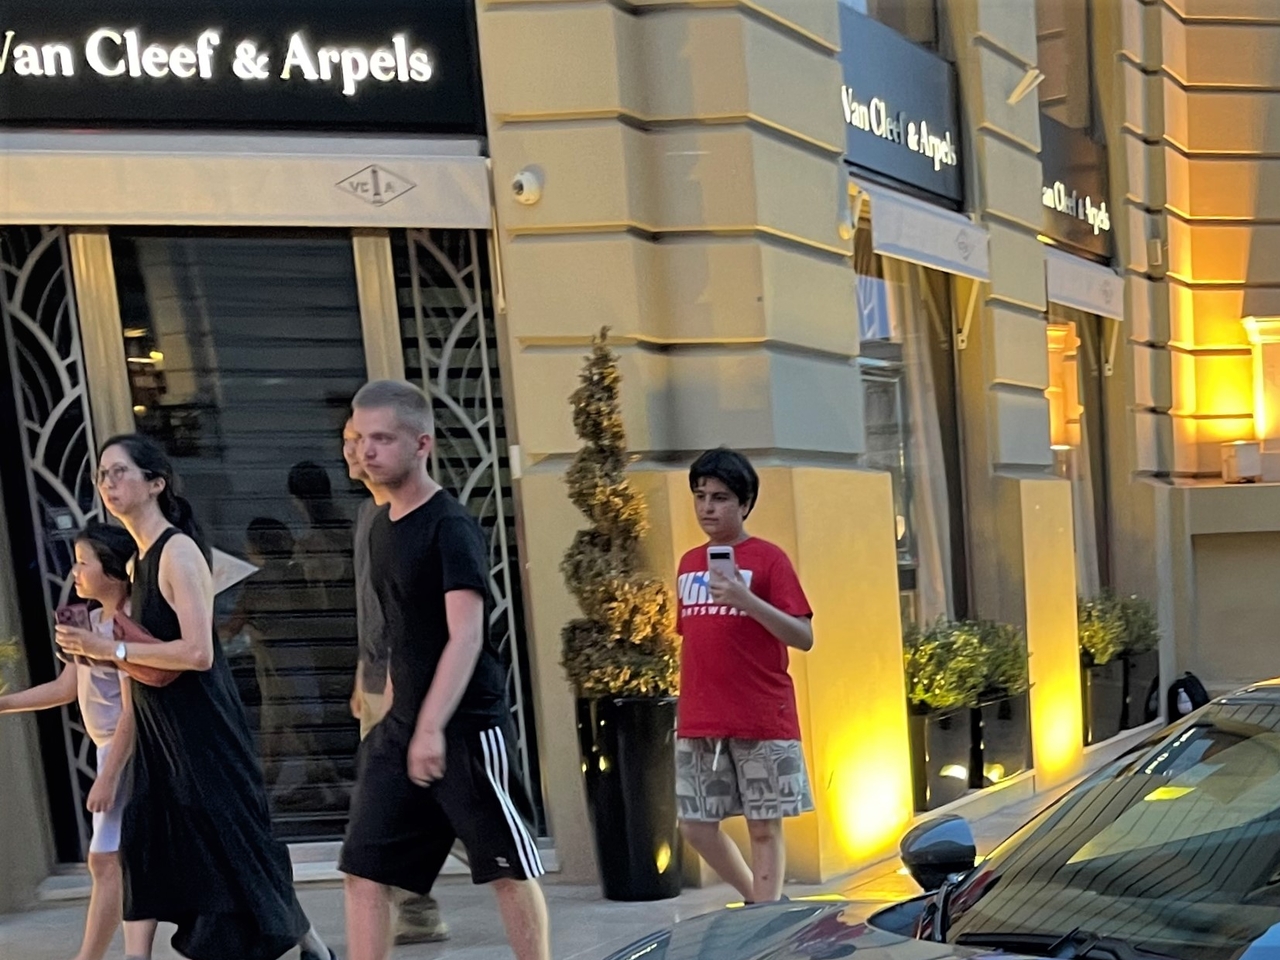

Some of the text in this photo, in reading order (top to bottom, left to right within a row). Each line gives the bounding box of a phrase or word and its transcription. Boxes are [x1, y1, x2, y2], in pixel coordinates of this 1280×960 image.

[85, 30, 220, 78] Cleef
[232, 41, 270, 80] &
[281, 32, 433, 96] Arpels
[842, 85, 870, 131] Van
[919, 121, 957, 172] Arpels
